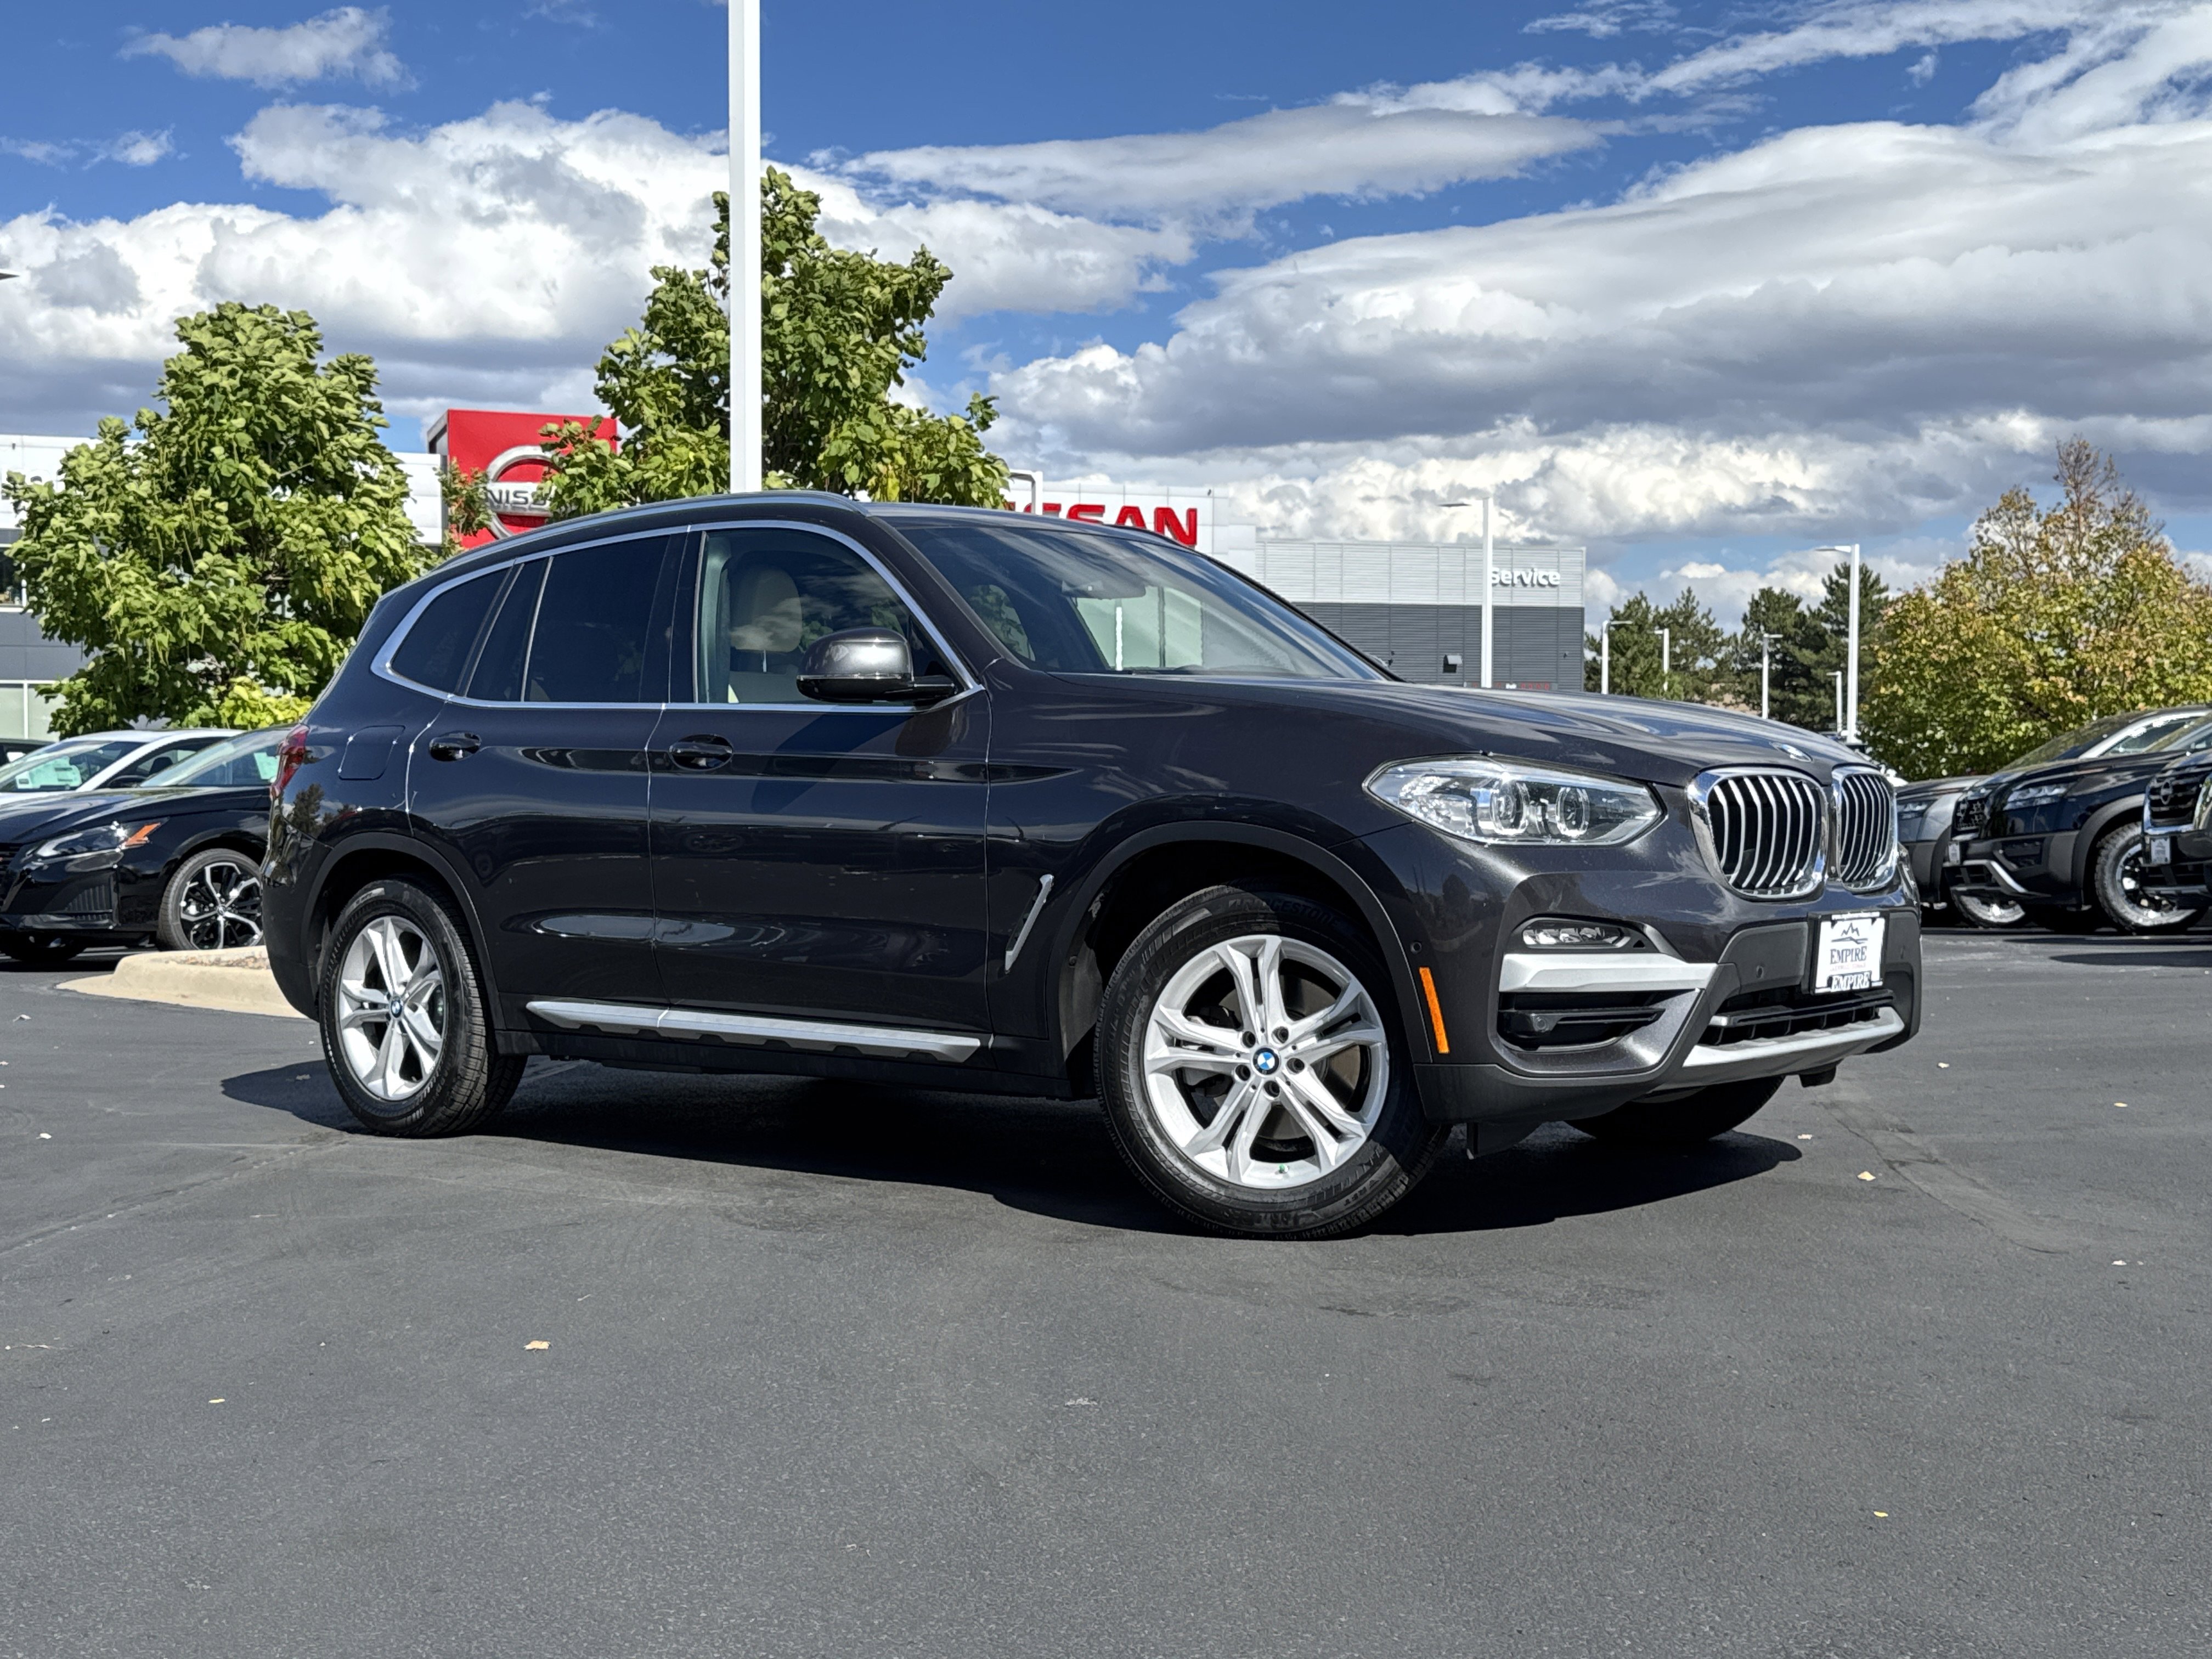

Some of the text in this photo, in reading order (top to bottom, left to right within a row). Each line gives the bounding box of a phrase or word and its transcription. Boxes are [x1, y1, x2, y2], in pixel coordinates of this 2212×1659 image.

[1491, 567, 1561, 586] Service
[1830, 946, 1867, 964] EMPIRE
[1831, 972, 1871, 992] EMPIRE
